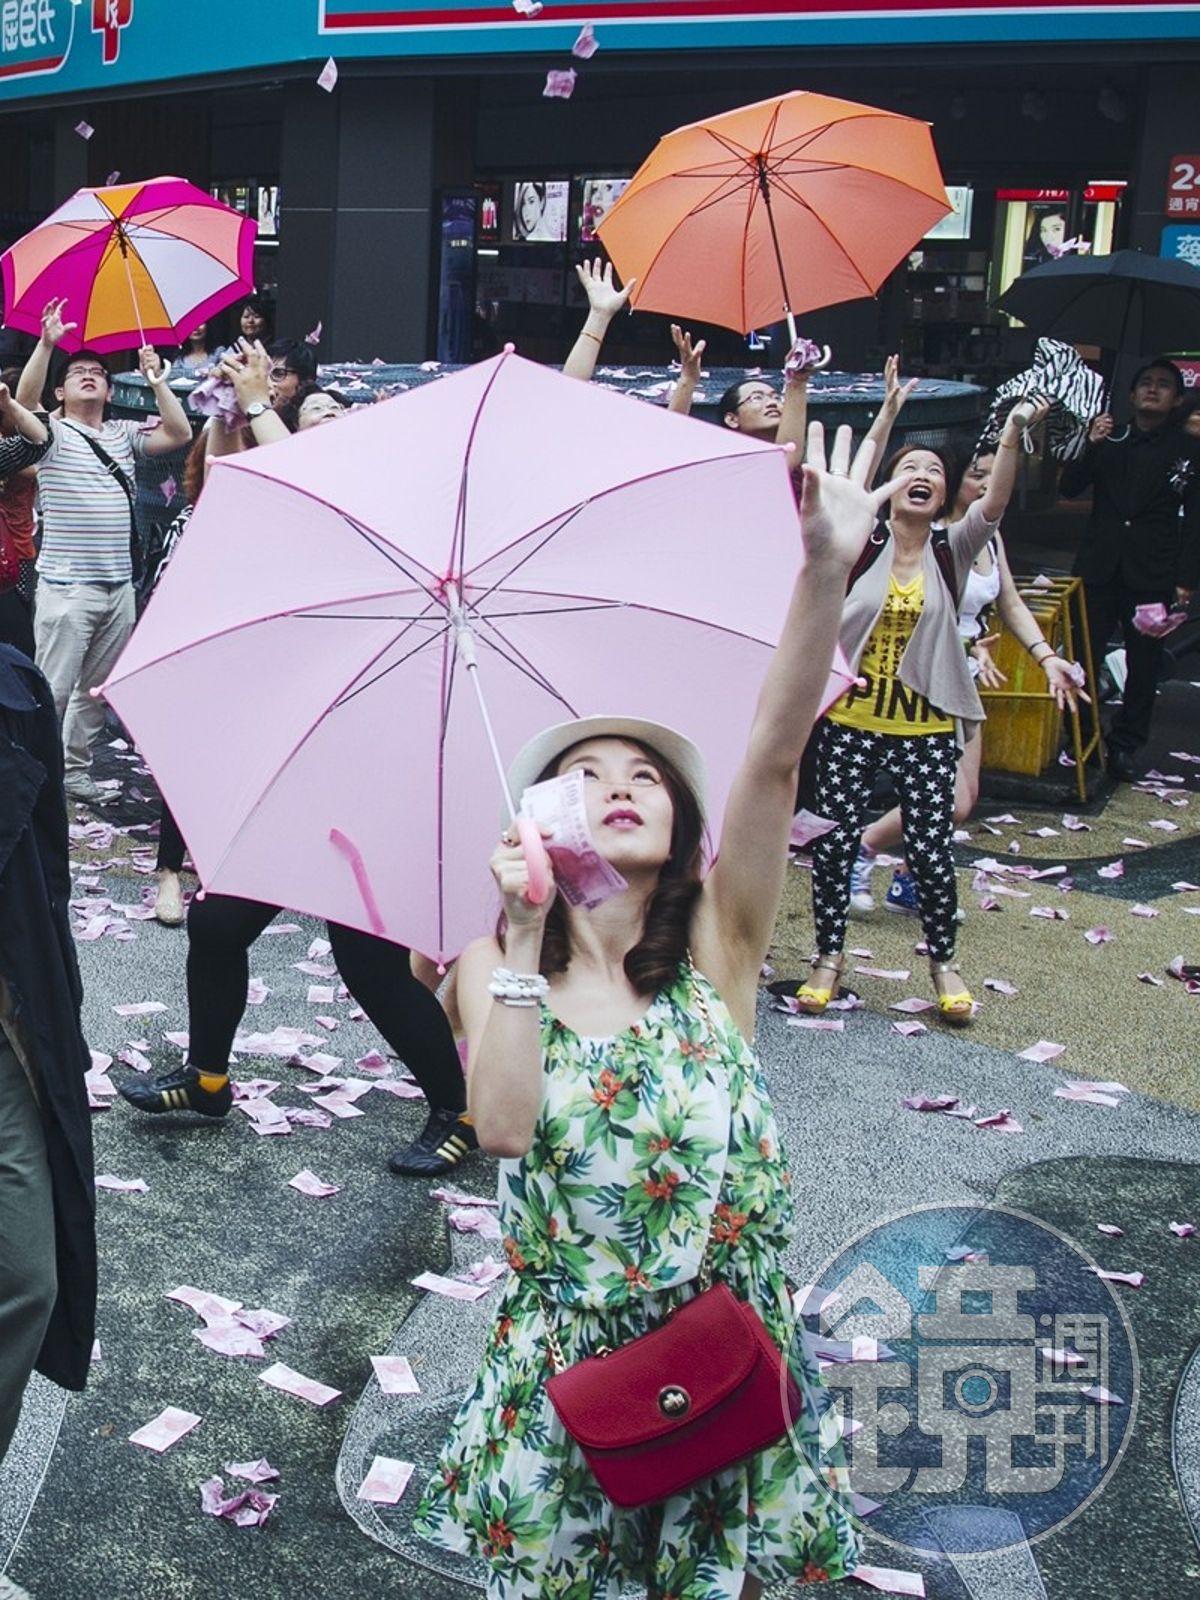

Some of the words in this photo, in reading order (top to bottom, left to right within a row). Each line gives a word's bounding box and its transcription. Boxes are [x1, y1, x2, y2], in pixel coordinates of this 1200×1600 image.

[2, 0, 56, 52] 屈臣氏
[1171, 163, 1200, 190] 2
